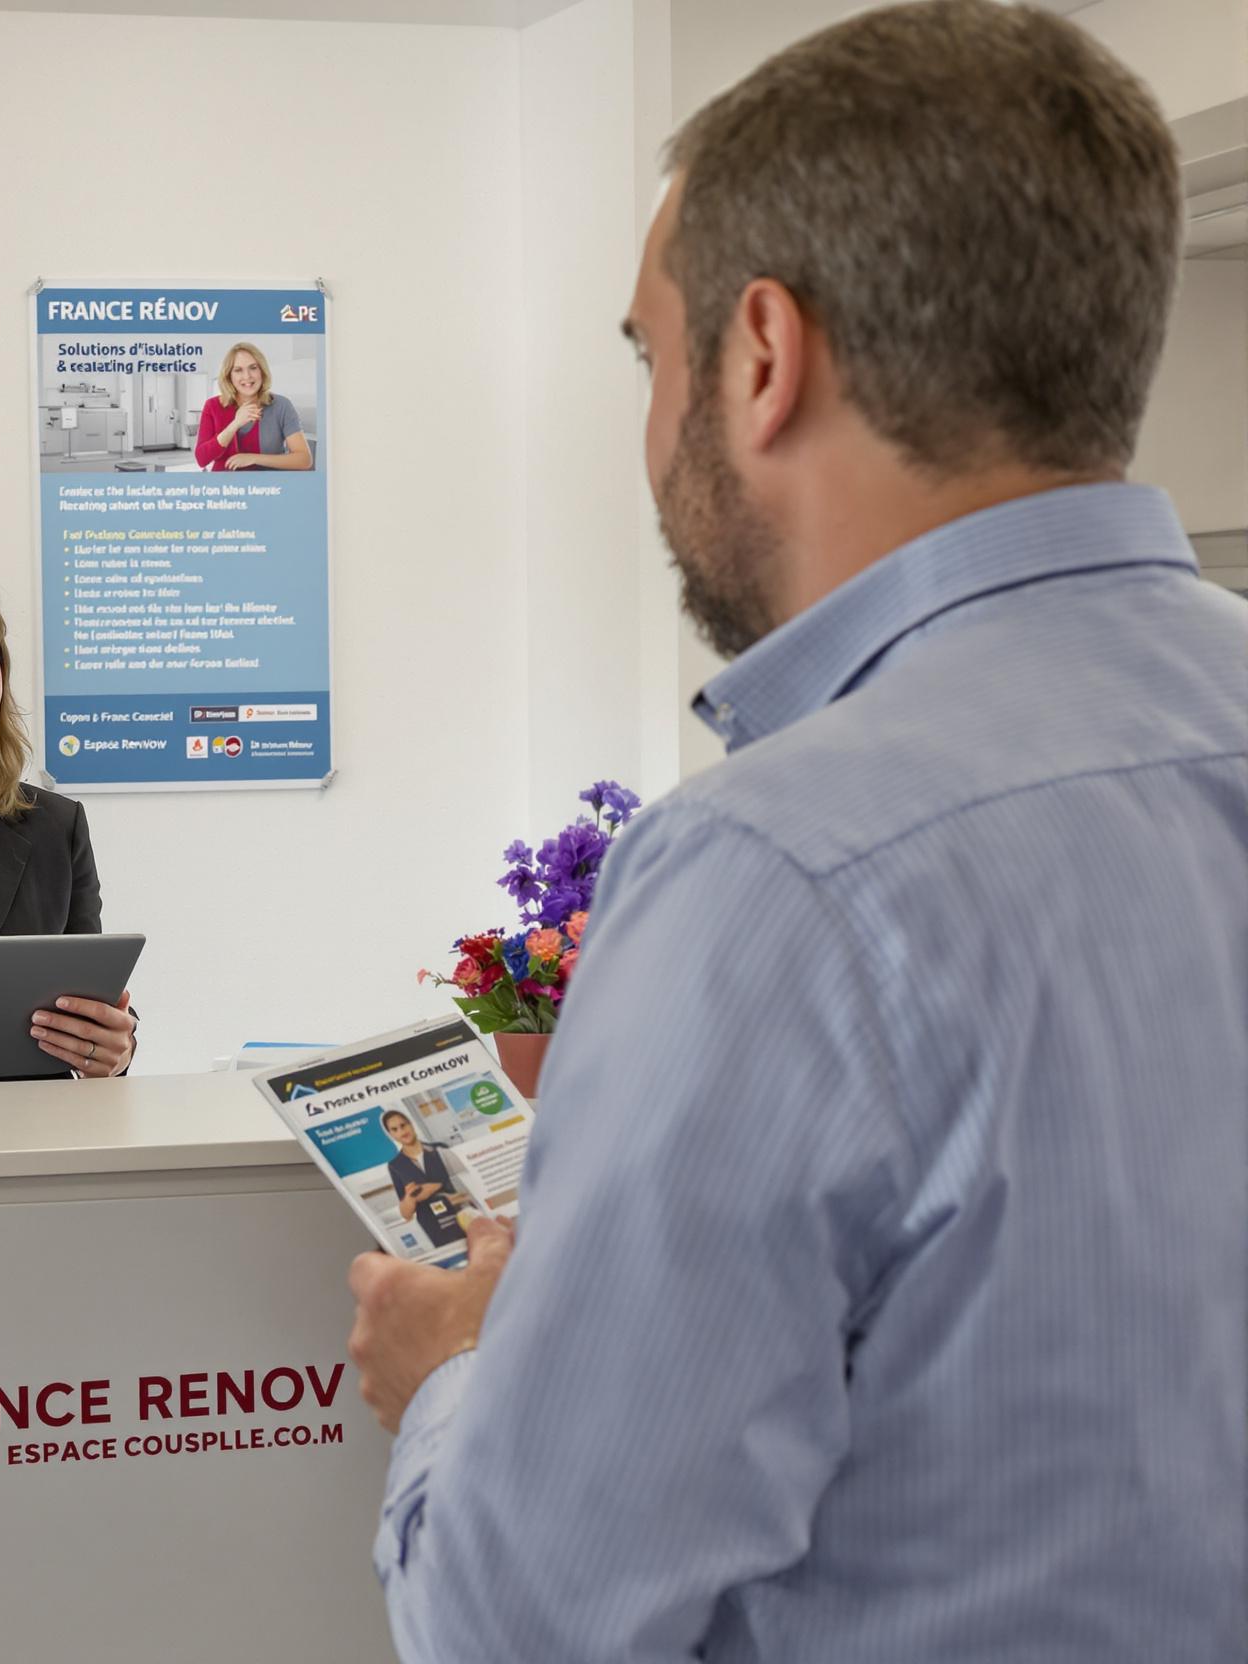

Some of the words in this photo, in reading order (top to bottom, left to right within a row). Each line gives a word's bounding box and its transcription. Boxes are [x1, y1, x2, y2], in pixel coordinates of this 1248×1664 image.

[48, 301, 133, 321] FRANCE
[139, 297, 219, 321] RÉNOV
[58, 343, 126, 356] Solutions
[56, 361, 67, 372] &
[139, 1363, 346, 1421] RENOV
[7, 1436, 118, 1466] ESPACE
[123, 1423, 345, 1459] COUSPLLE.CO.M
